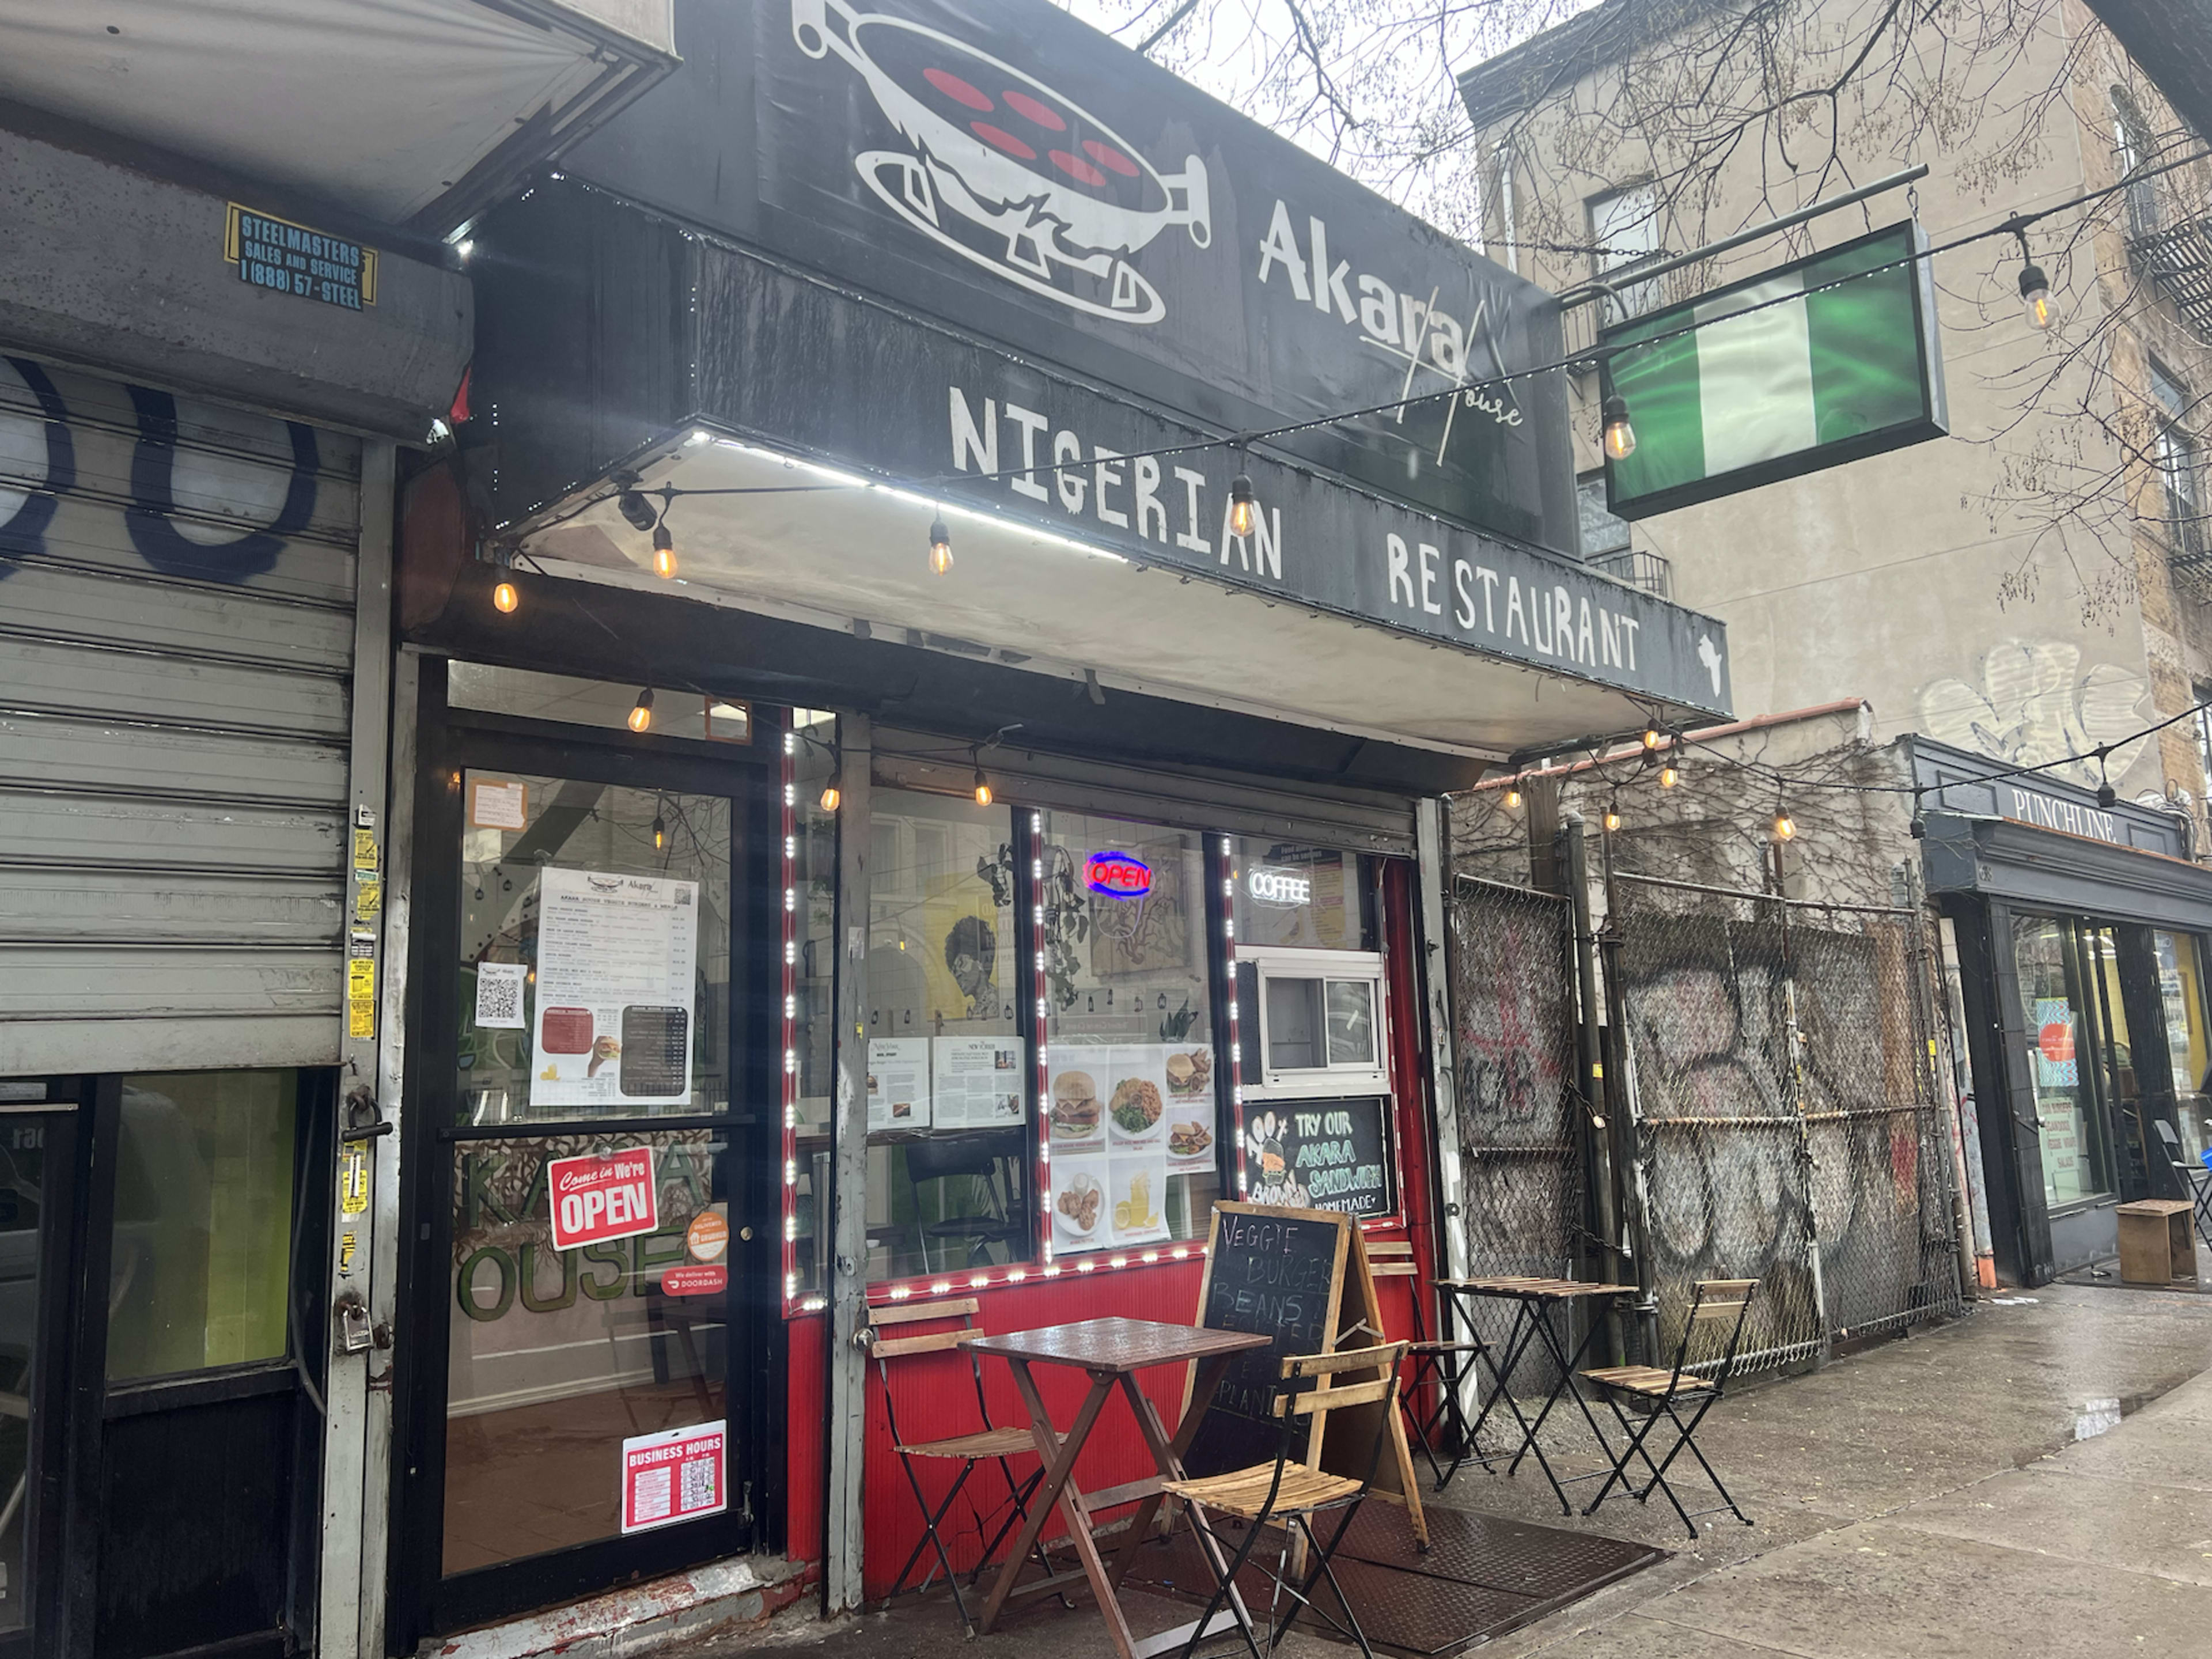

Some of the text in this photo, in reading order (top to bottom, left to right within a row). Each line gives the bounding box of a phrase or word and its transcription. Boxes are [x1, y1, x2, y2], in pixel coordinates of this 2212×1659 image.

[242, 215, 360, 267] STEELMASTERS
[245, 240, 357, 286] SALES AND SERVICE
[251, 262, 290, 292] (888)
[1259, 199, 1467, 377] Akara
[949, 386, 1639, 671] NIGERIAN RESTAURANT
[2012, 789, 2118, 844] PUNCHLINE
[1092, 863, 1151, 889] OPEN
[1252, 872, 1310, 902] COFFEE
[1295, 1111, 1353, 1138] TRY OUR
[1296, 1139, 1356, 1168] AKARA
[560, 1161, 645, 1192] Come in We're
[560, 1182, 647, 1234] OPEN
[1315, 1194, 1372, 1211] HOMEMADE
[681, 1279, 722, 1287] DOORDASH
[1212, 1282, 1302, 1324] BEANS
[630, 1437, 721, 1467] BUSINESS HOURS
